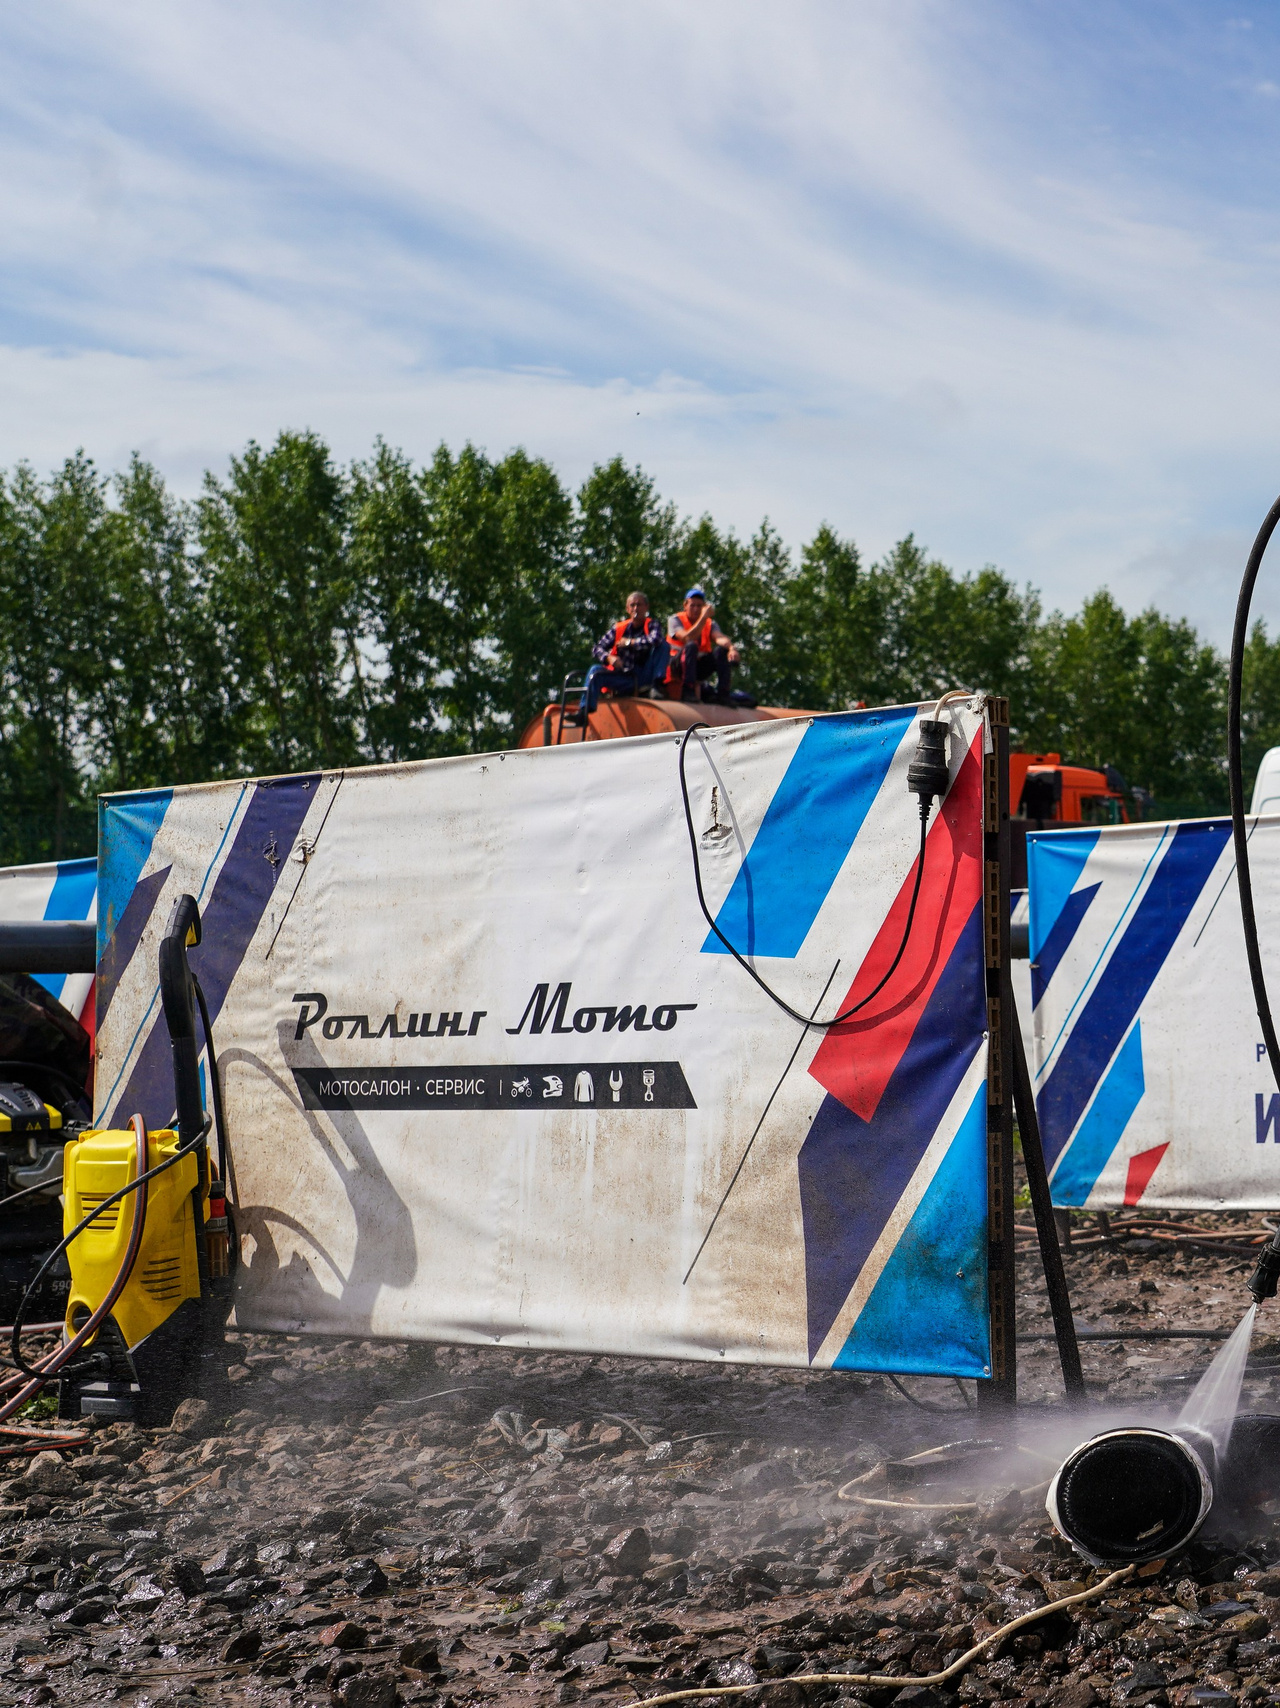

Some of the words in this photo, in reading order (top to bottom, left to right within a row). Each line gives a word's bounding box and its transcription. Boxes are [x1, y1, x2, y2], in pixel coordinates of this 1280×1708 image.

[291, 993, 487, 1041] Роллинг
[505, 982, 698, 1035] Мото
[319, 1079, 411, 1097] МОТОСАЛОН
[425, 1078, 486, 1096] СЕРВИС
